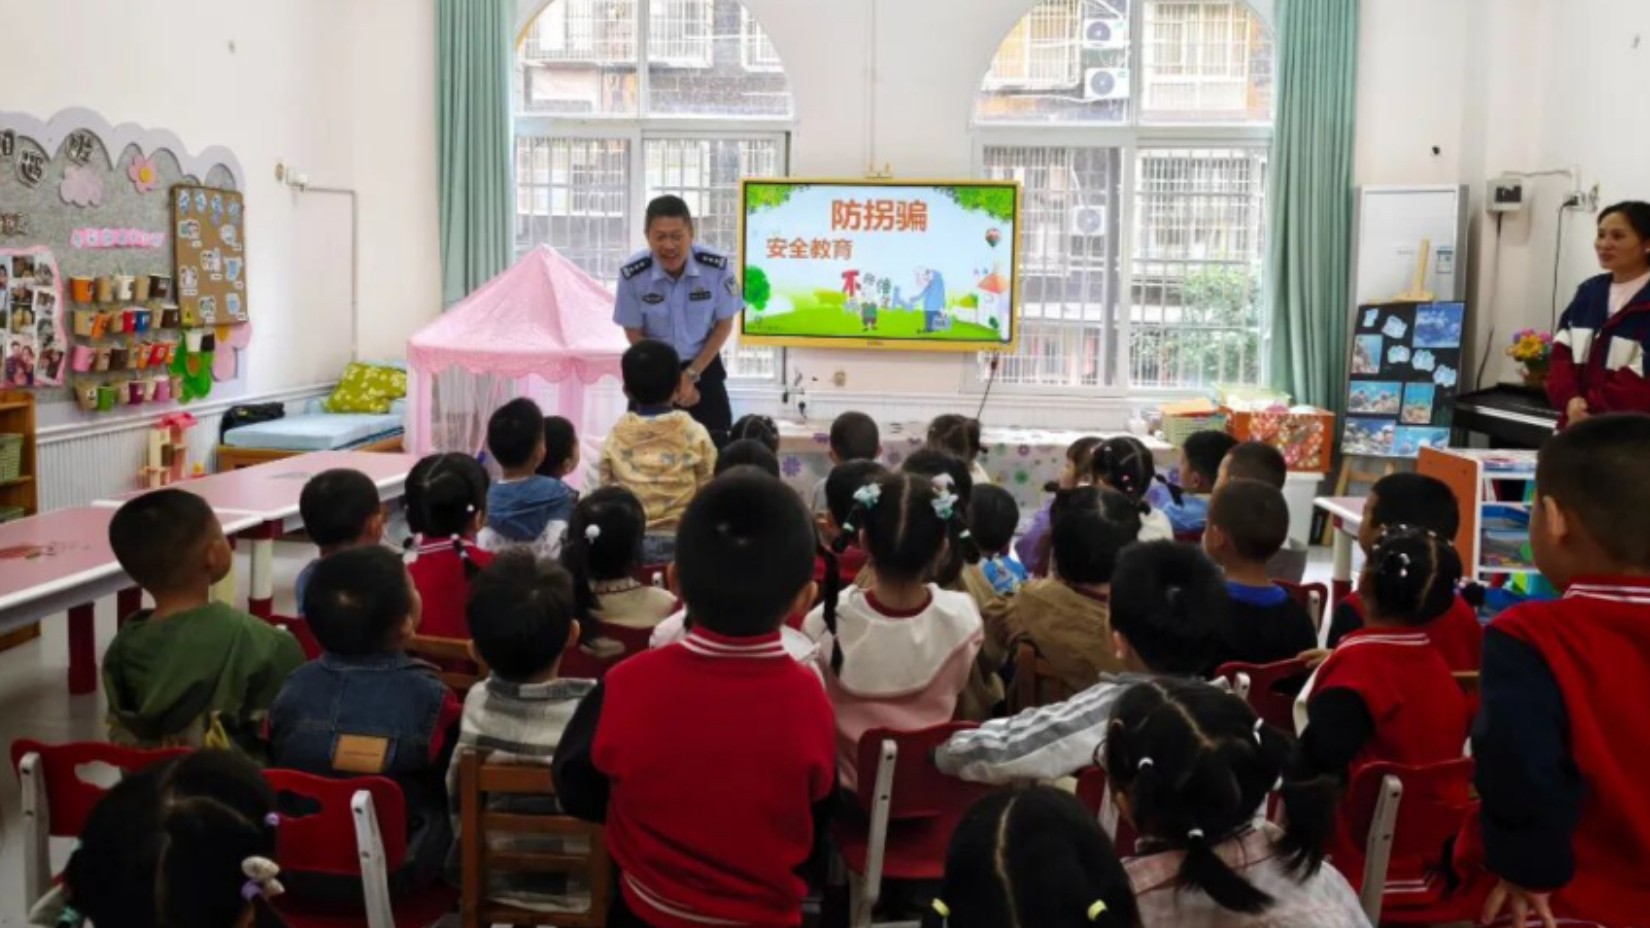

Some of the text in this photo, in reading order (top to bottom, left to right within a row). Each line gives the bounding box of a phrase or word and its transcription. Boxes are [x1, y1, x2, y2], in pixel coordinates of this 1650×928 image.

[832, 199, 928, 232] 防拐骗
[766, 237, 854, 260] 安全教育
